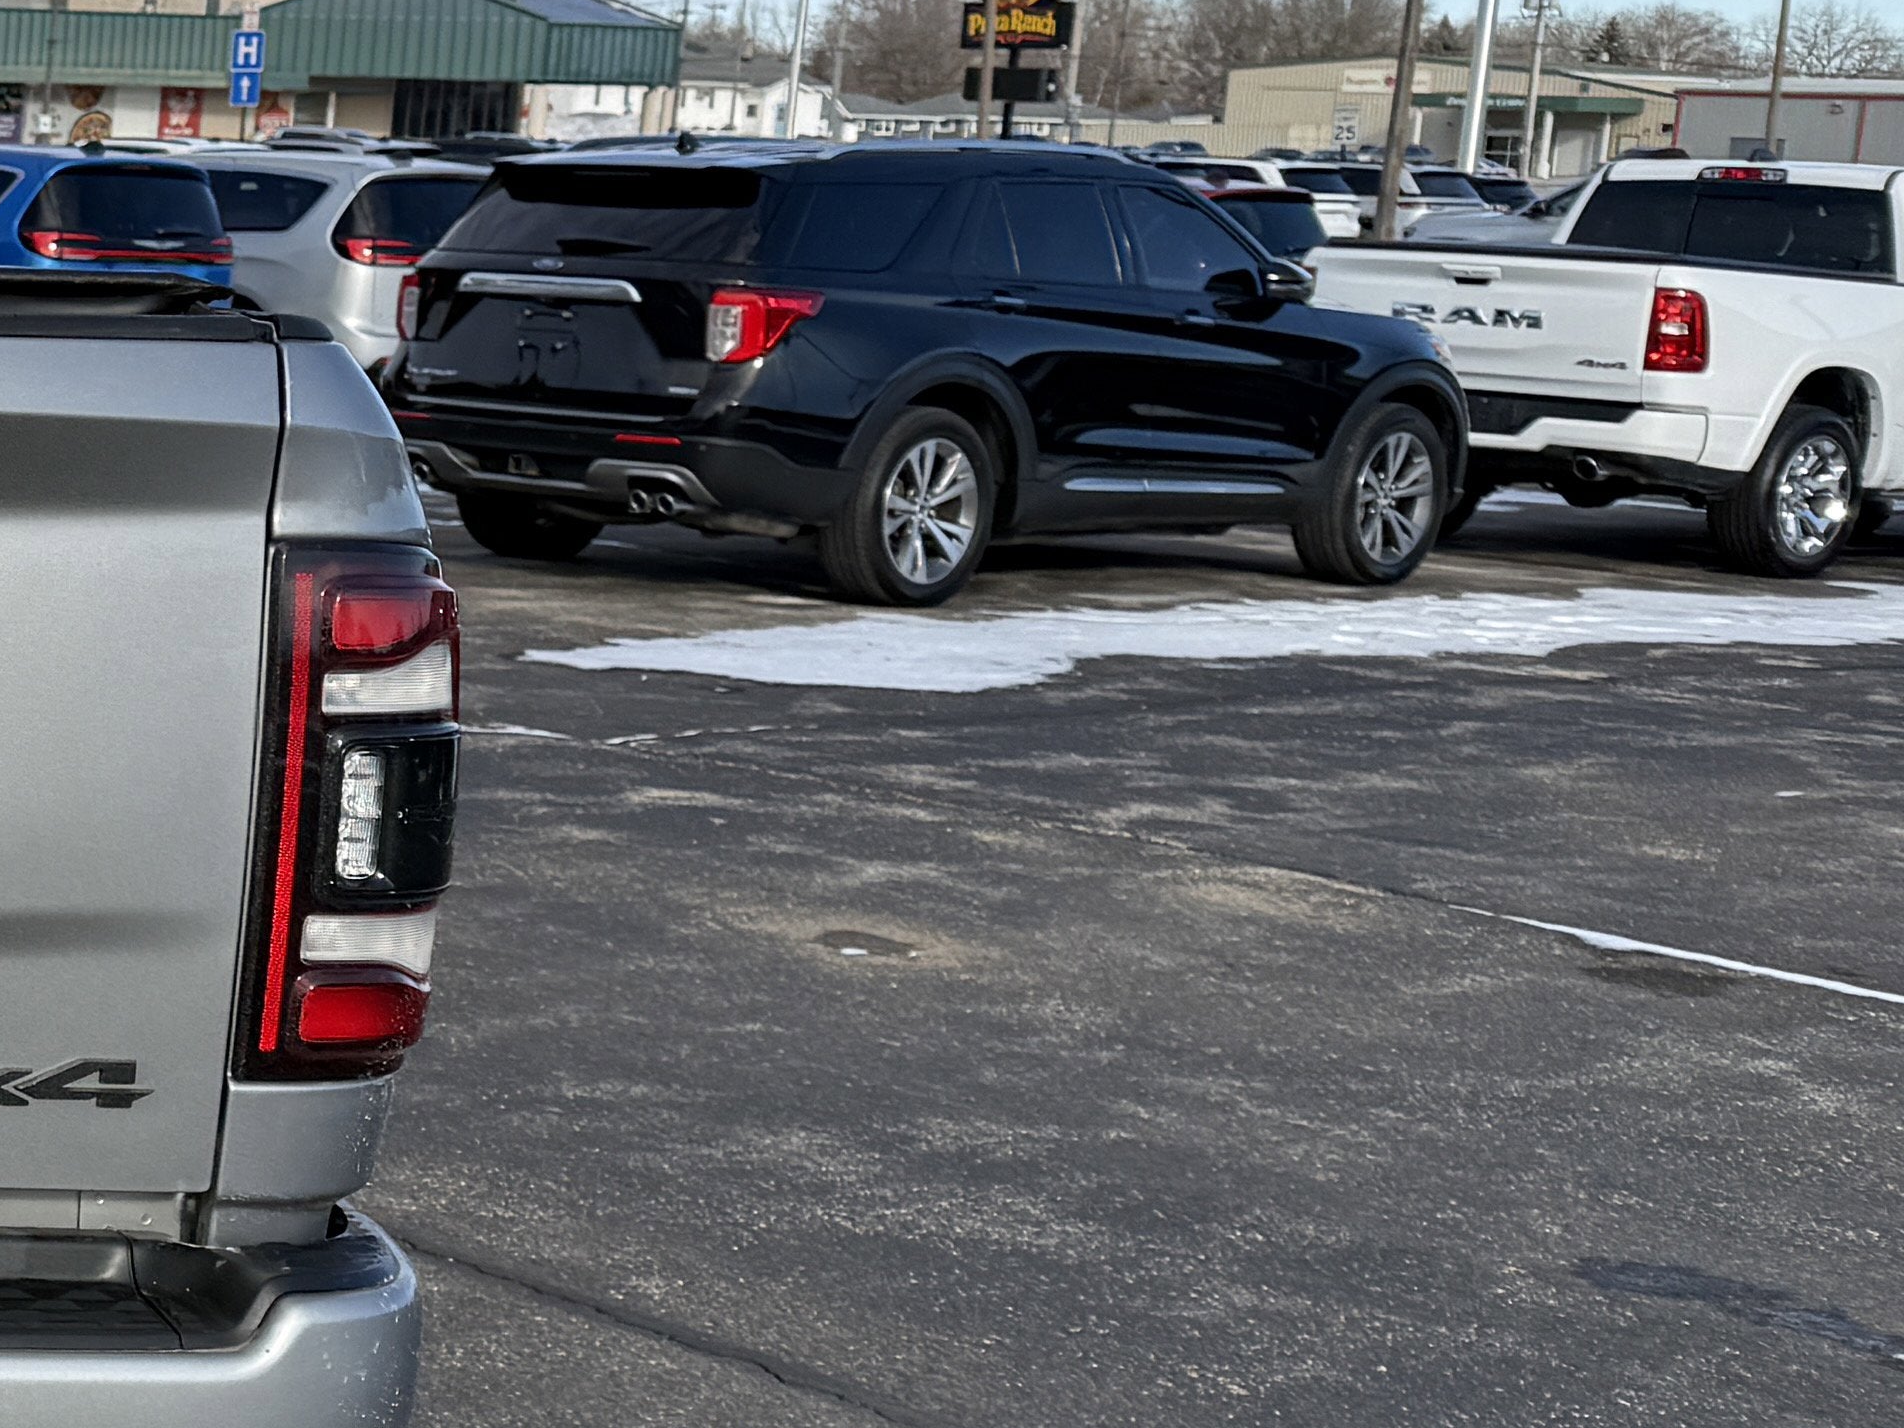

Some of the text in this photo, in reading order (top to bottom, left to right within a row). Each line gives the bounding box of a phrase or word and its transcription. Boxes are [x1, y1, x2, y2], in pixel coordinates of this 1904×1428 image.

[967, 8, 1056, 37] Pia Ranch
[237, 36, 259, 66] H
[1334, 125, 1356, 141] 25
[1391, 301, 1543, 329] RAM
